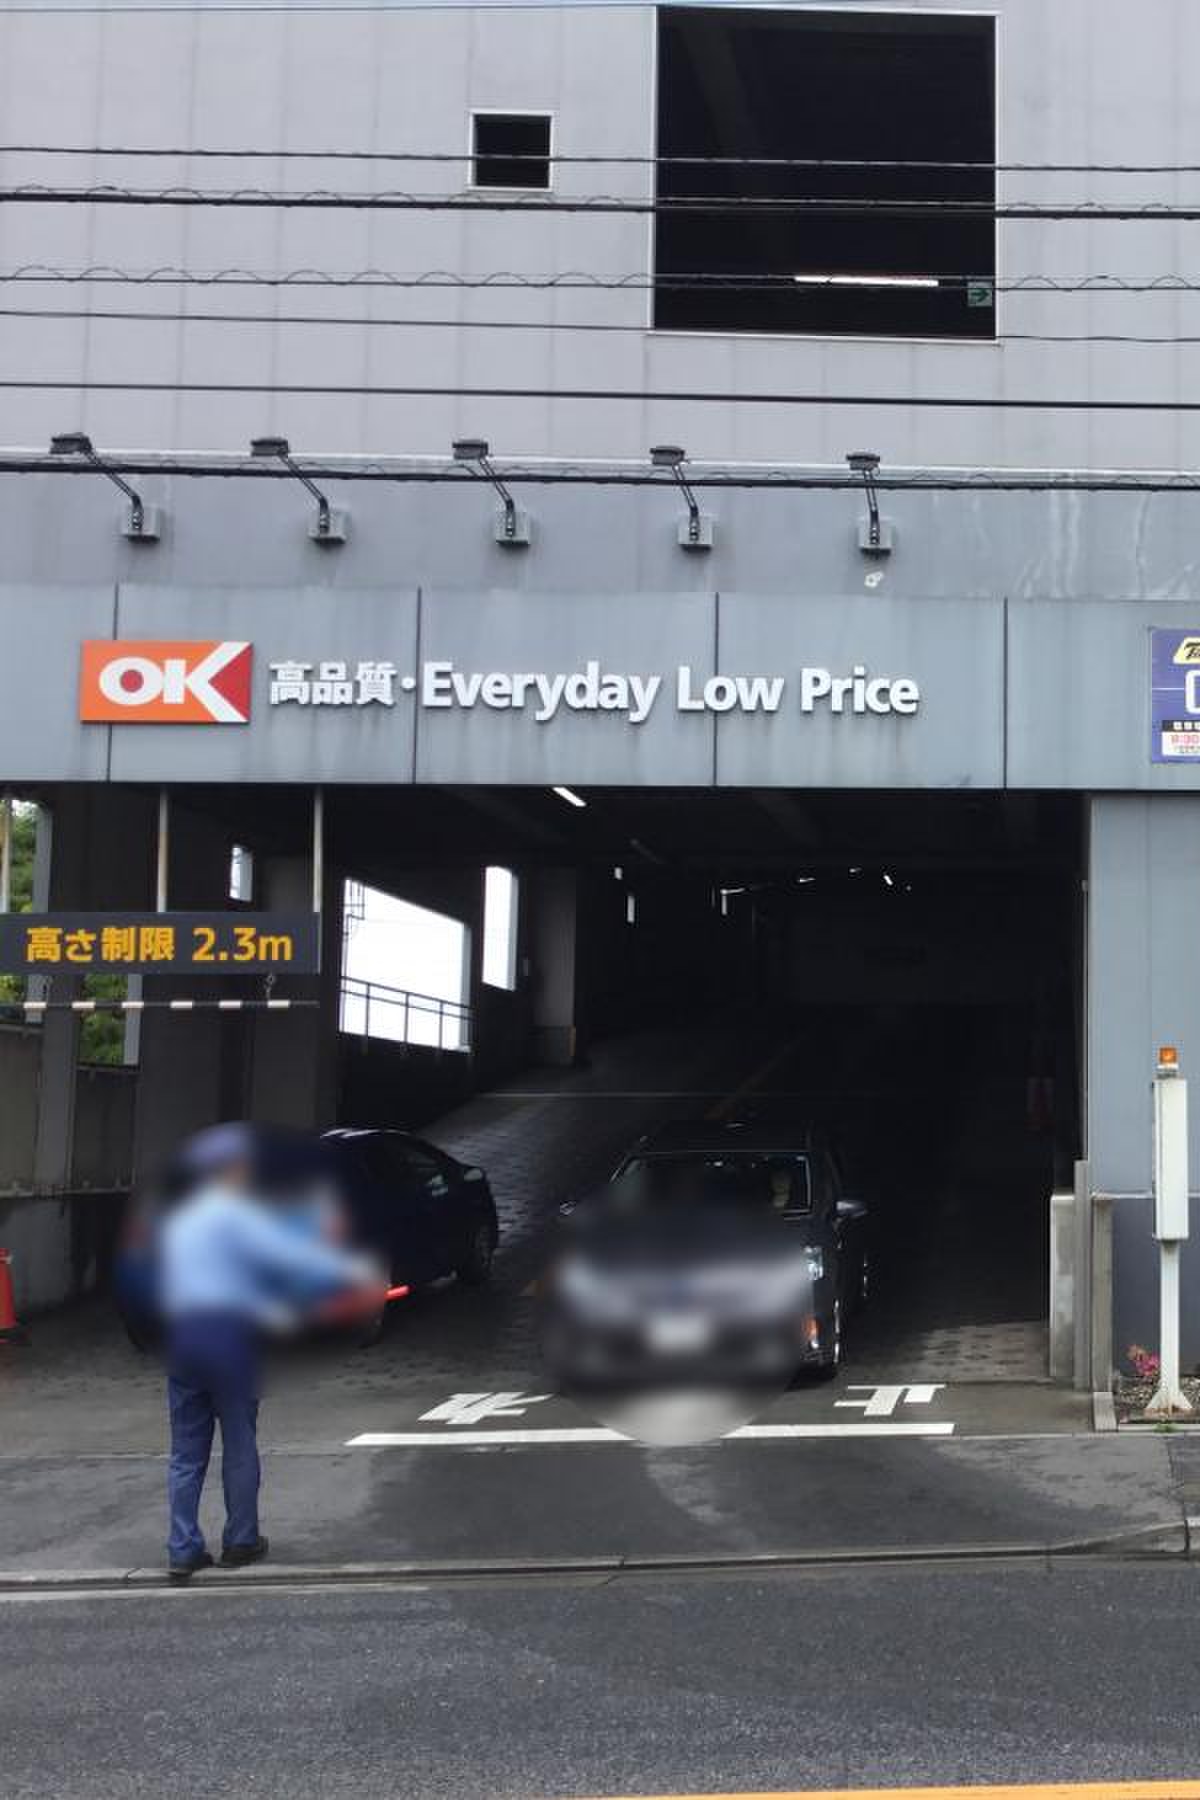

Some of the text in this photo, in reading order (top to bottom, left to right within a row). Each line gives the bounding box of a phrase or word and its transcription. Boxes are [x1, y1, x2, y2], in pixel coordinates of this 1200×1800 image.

[98, 641, 249, 722] OK
[677, 667, 785, 713] Low
[801, 666, 920, 714] Price
[26, 926, 293, 963] 高さ制限 2.3m
